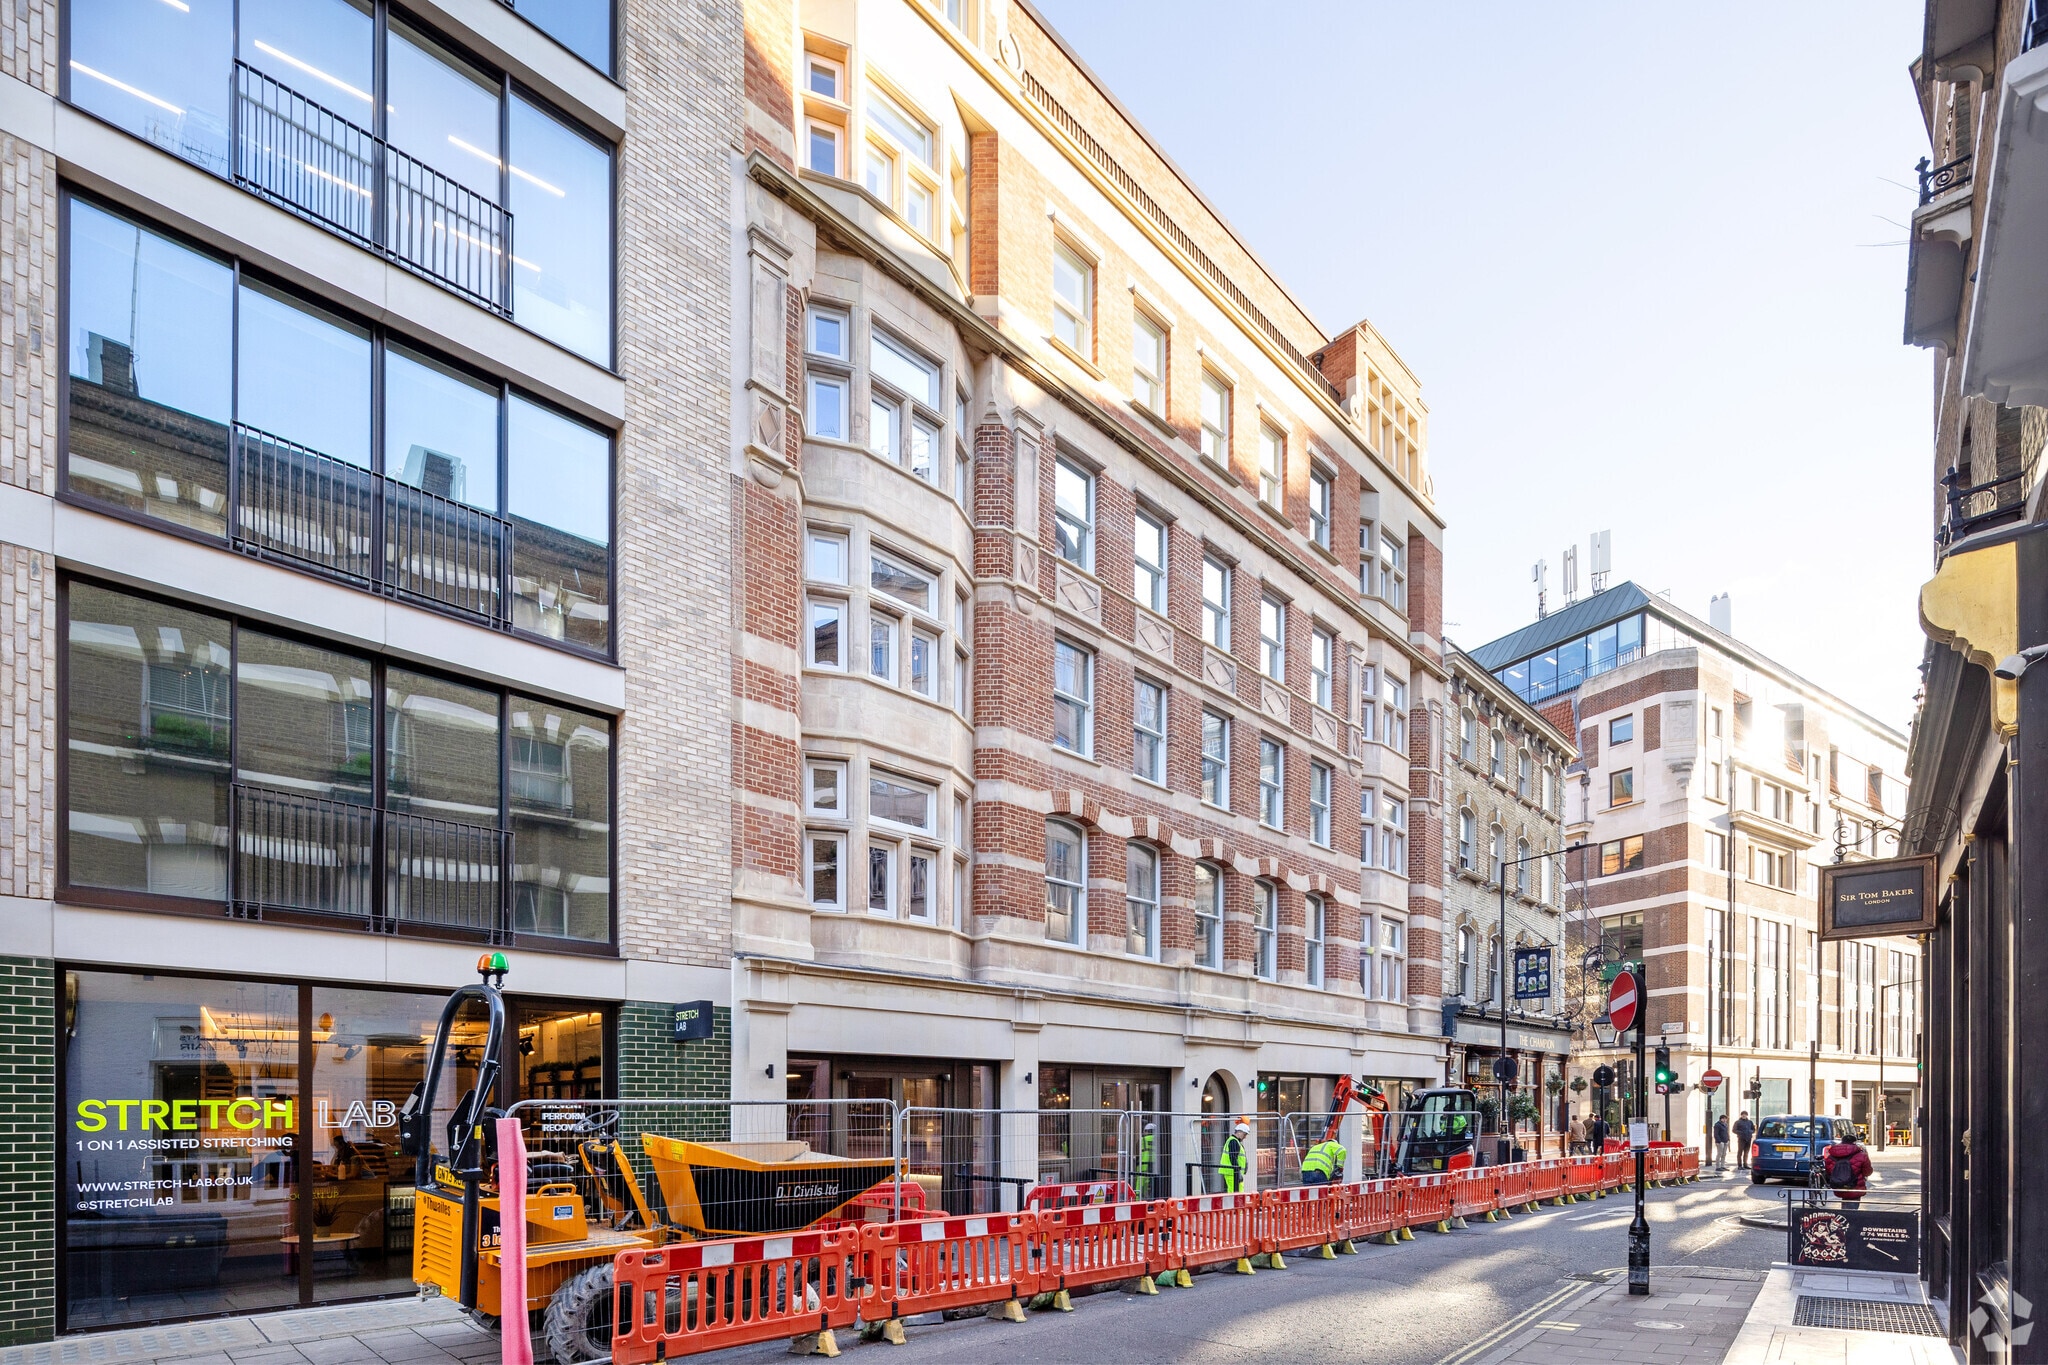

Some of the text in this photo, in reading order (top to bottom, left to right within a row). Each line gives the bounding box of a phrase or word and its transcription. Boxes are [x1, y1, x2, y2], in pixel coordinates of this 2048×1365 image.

[675, 1009, 699, 1021] STRETCH
[675, 1021, 687, 1032] LAB
[1519, 1034, 1555, 1049] THE CHAMPION
[75, 1099, 397, 1132] STRETCH LAB
[541, 1112, 586, 1120] PERFORM
[76, 1136, 293, 1151] 1 ON 1 ASSISTED STRETCHING
[76, 1176, 254, 1193] WWW.STRETCH-LAB.CO.UK
[793, 1184, 823, 1198] Civils
[825, 1183, 839, 1196] ltd
[76, 1197, 174, 1211] @STRETCHLAB
[427, 1197, 451, 1217] Thwaites
[1862, 1226, 1907, 1234] DOWNSTAIRS
[482, 1234, 491, 1247] 3
